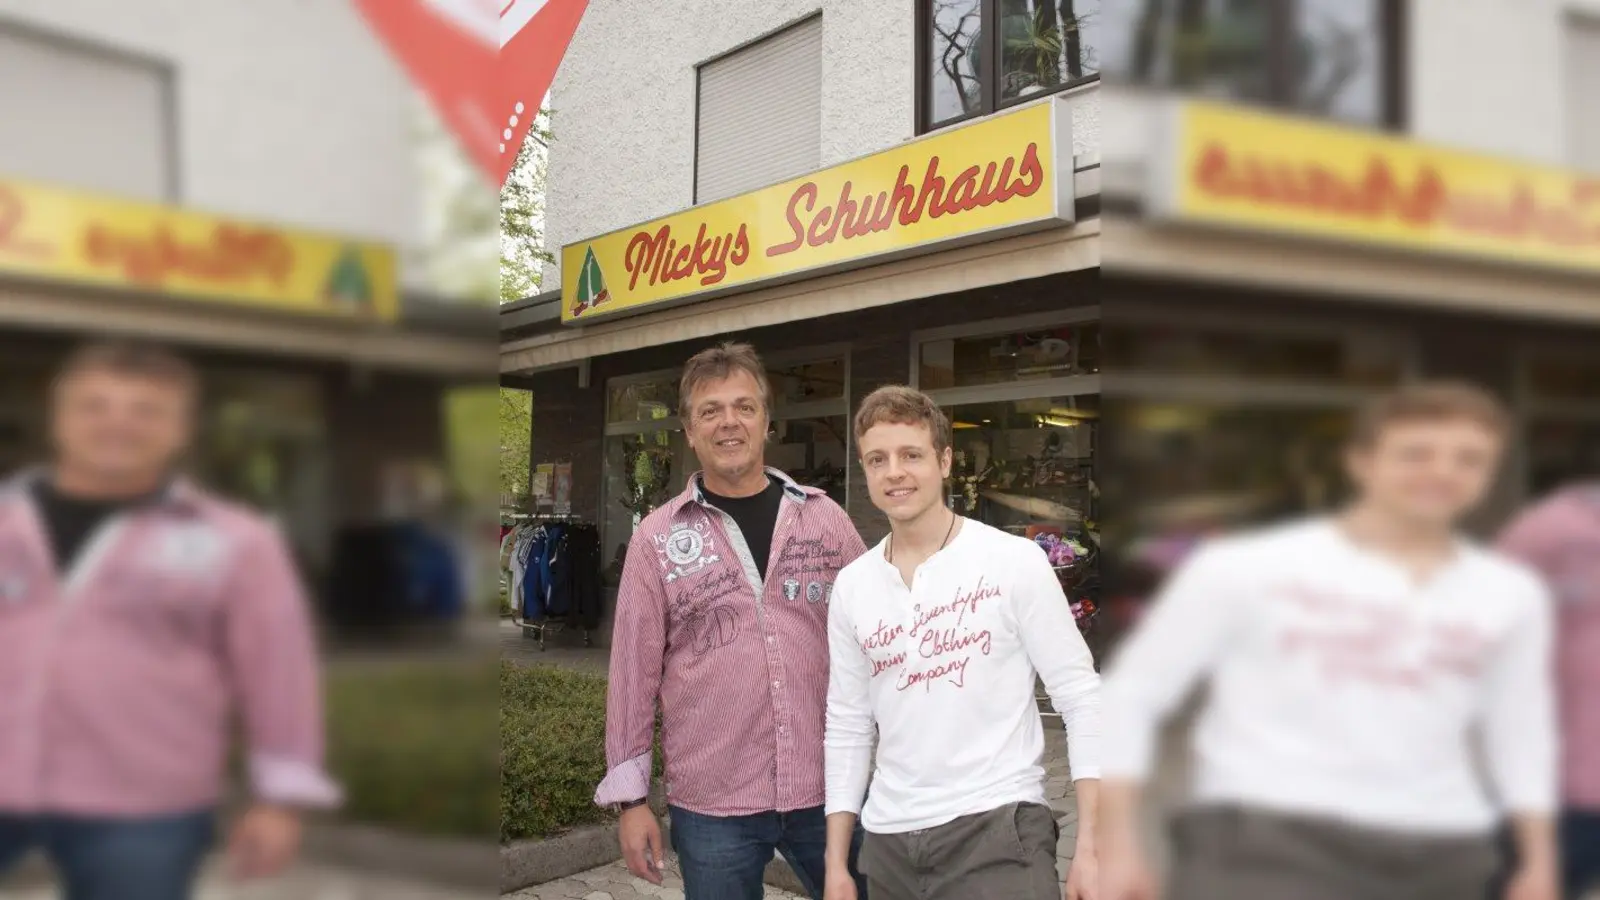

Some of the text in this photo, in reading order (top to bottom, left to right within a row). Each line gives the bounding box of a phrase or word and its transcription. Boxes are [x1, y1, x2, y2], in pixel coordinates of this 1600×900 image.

[624, 142, 1044, 290] Mickys Schuhhaus
[918, 627, 992, 658] Clothing
[896, 656, 970, 693] Company
